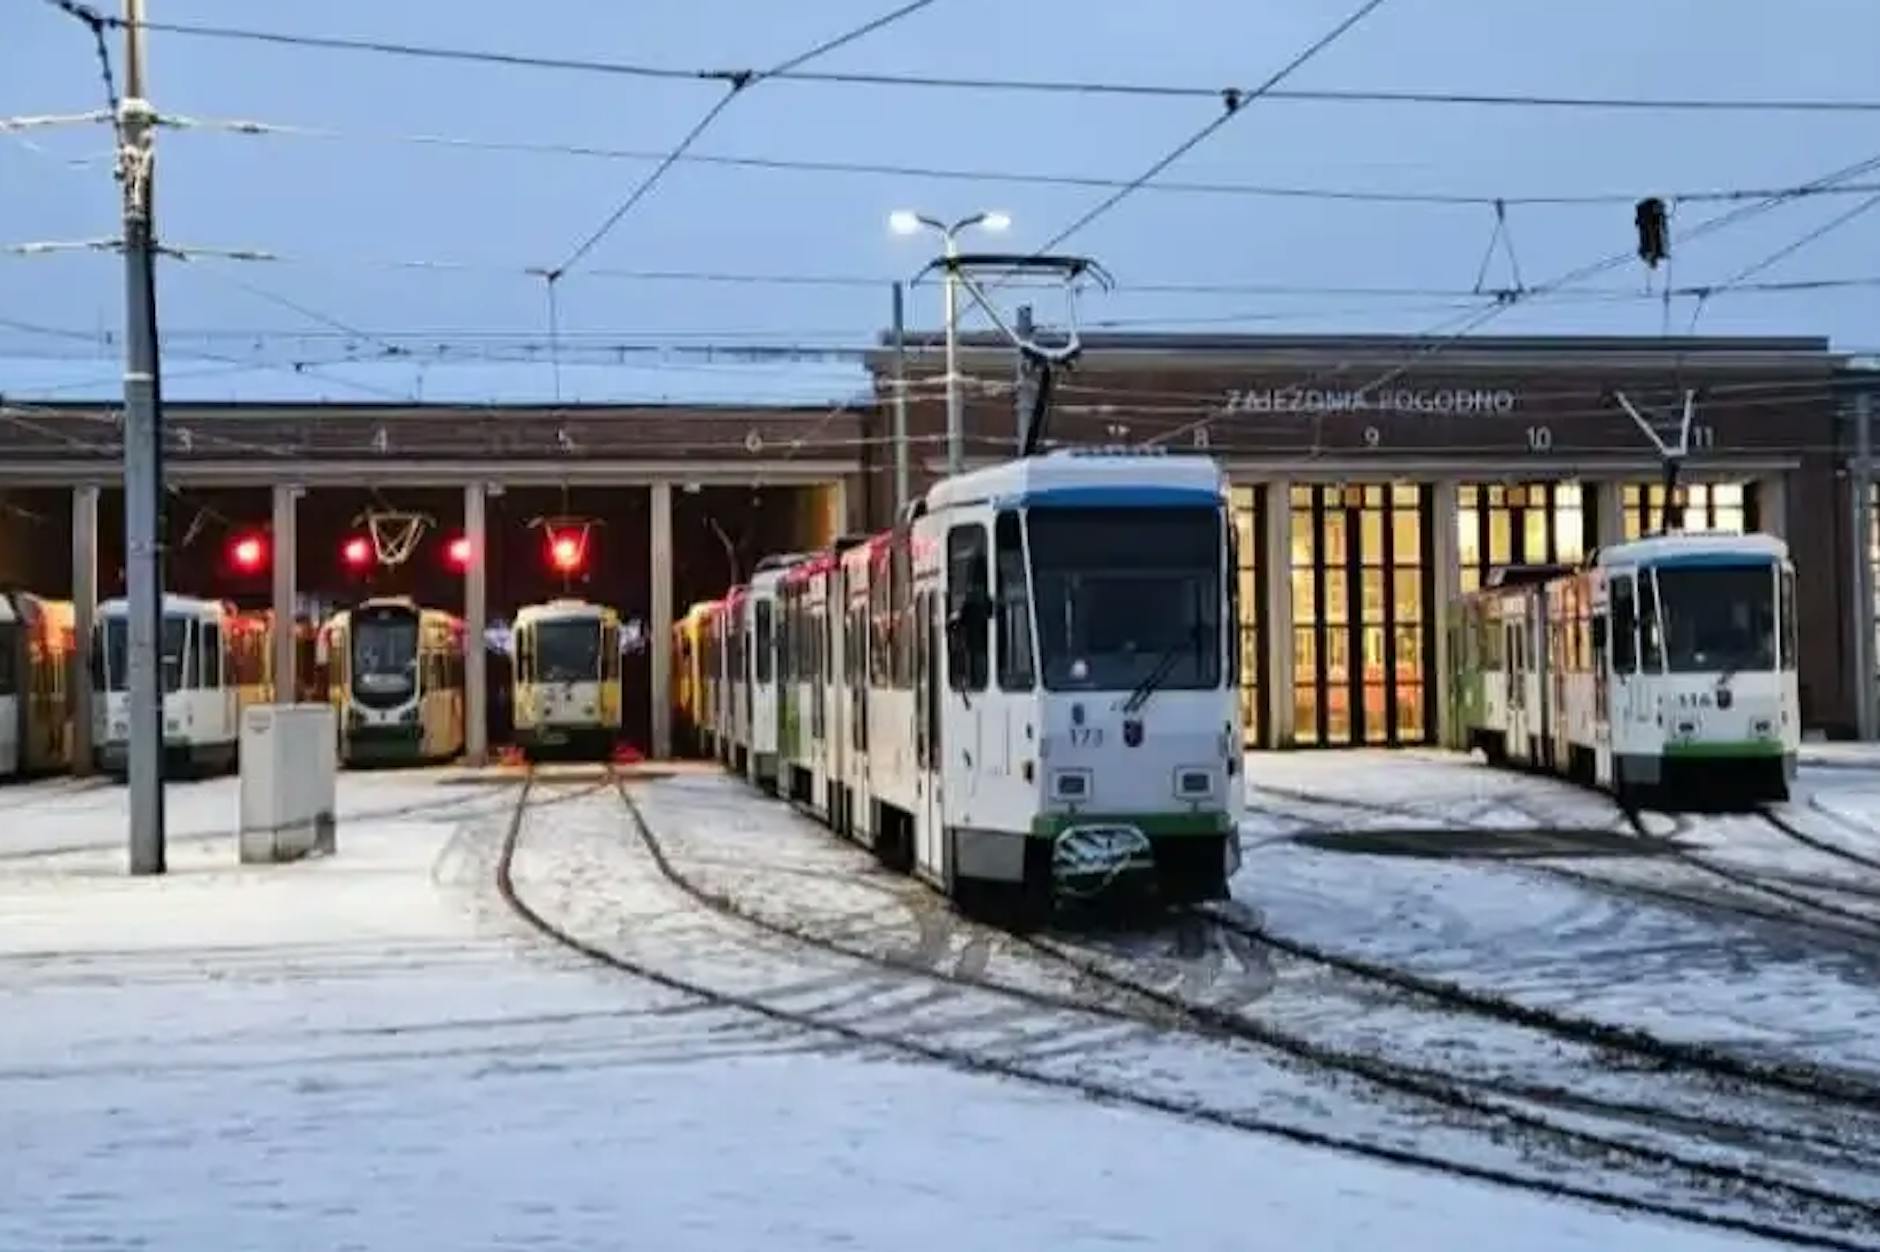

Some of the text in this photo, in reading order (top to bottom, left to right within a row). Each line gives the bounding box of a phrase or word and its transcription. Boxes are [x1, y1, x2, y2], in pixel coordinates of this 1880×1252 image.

[176, 427, 193, 453] 3
[371, 427, 388, 453] 4
[745, 427, 763, 453] 6
[1194, 427, 1210, 448] 8
[1364, 426, 1380, 446] 9
[1526, 426, 1552, 449] 10
[1694, 426, 1714, 447] 11
